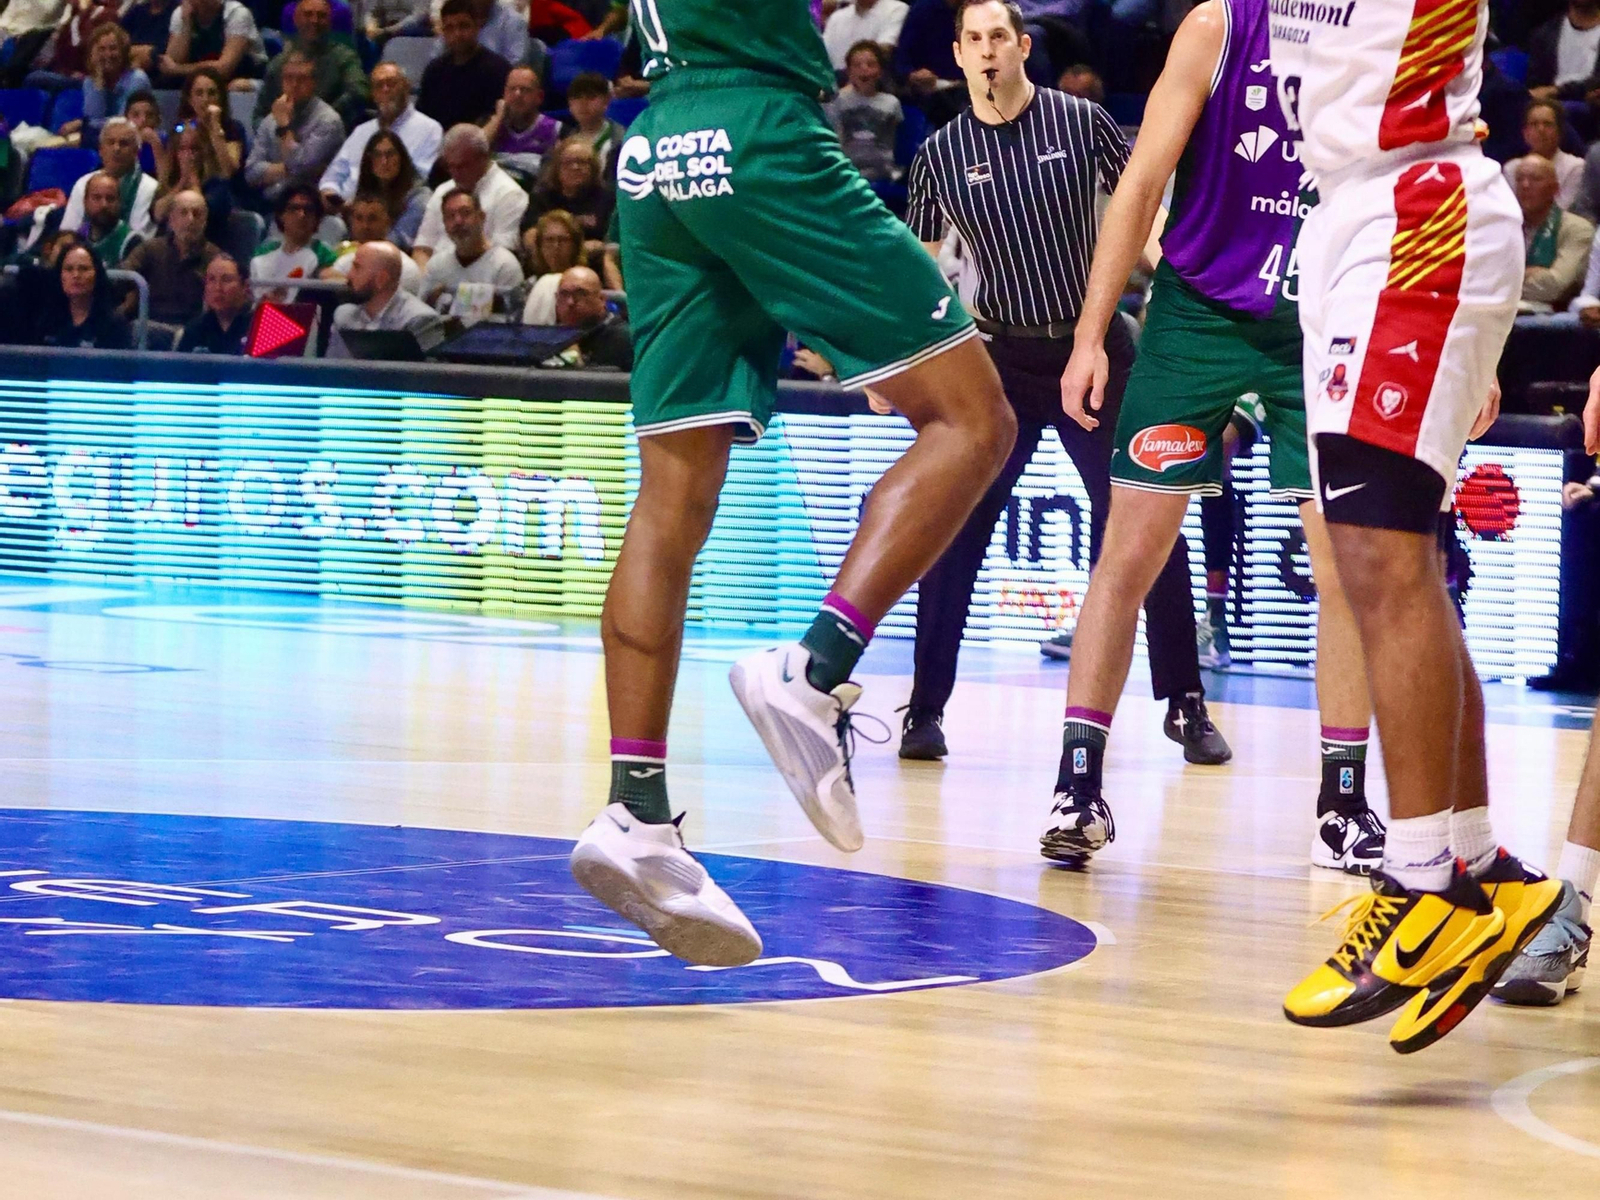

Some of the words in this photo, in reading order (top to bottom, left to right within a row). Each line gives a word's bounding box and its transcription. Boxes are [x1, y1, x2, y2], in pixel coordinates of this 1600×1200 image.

[1271, 24, 1311, 44] ARAGOZA
[656, 128, 733, 160] COSTA
[654, 160, 686, 182] DEL
[686, 154, 733, 177] SOL
[1250, 190, 1313, 219] mála
